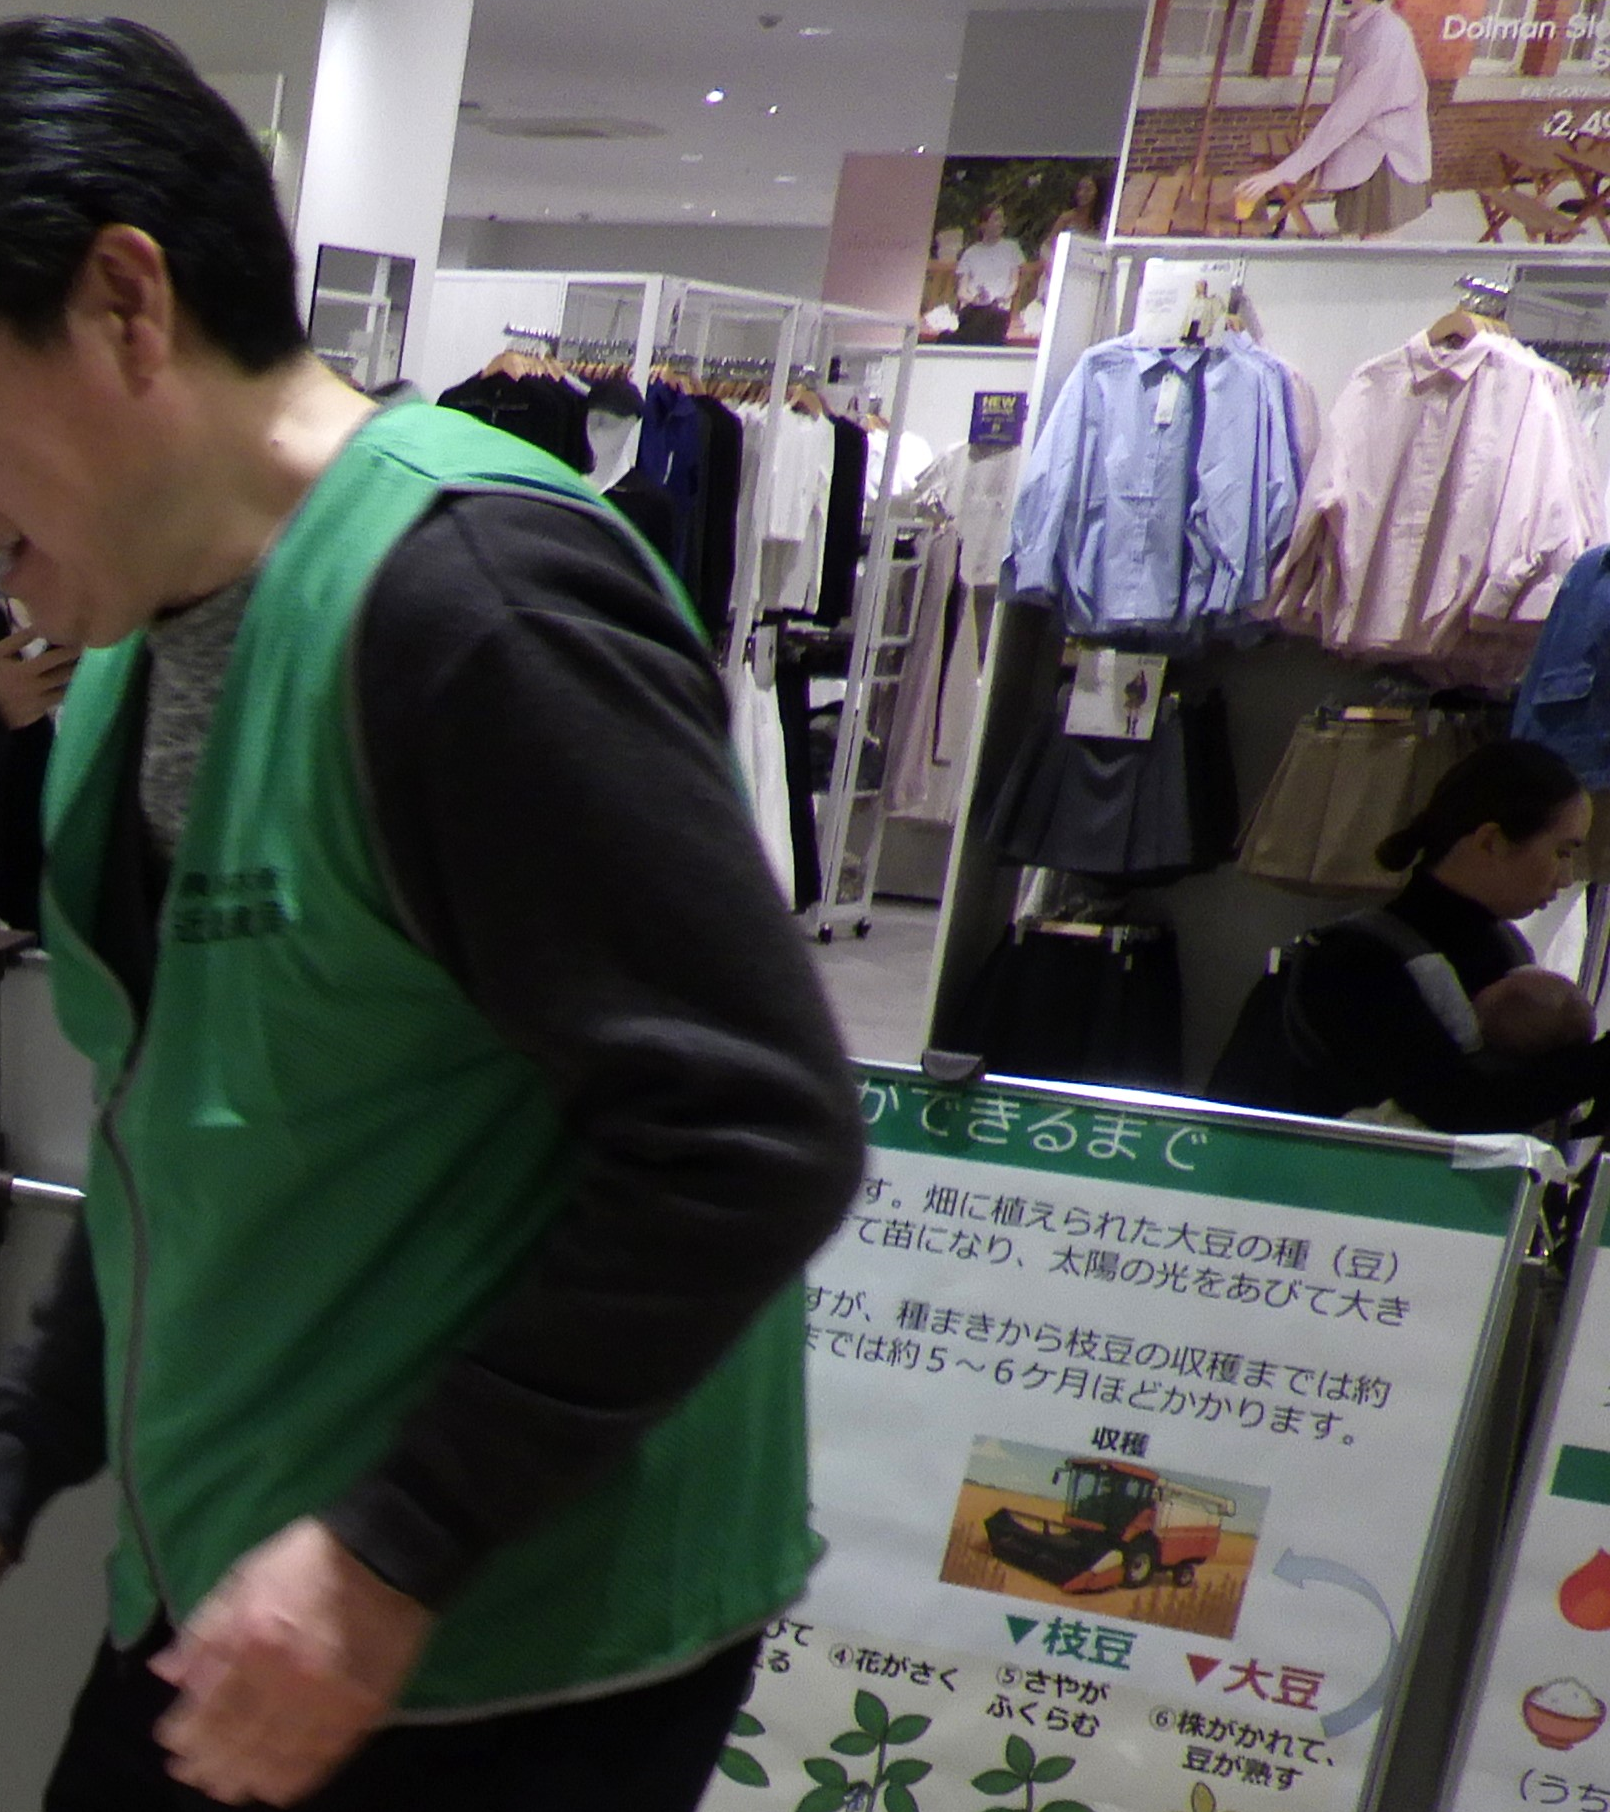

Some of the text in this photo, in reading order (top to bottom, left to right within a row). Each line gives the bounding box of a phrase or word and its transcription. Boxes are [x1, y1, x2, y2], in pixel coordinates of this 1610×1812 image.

[1441, 13, 1557, 41] Dolman
[1092, 1426, 1150, 1458] 収穫
[1041, 1614, 1138, 1672] 枝豆
[1223, 1657, 1327, 1713] 大豆
[986, 1693, 1101, 1739] ふくらむ
[1182, 1745, 1304, 1792] 豆が熟す
